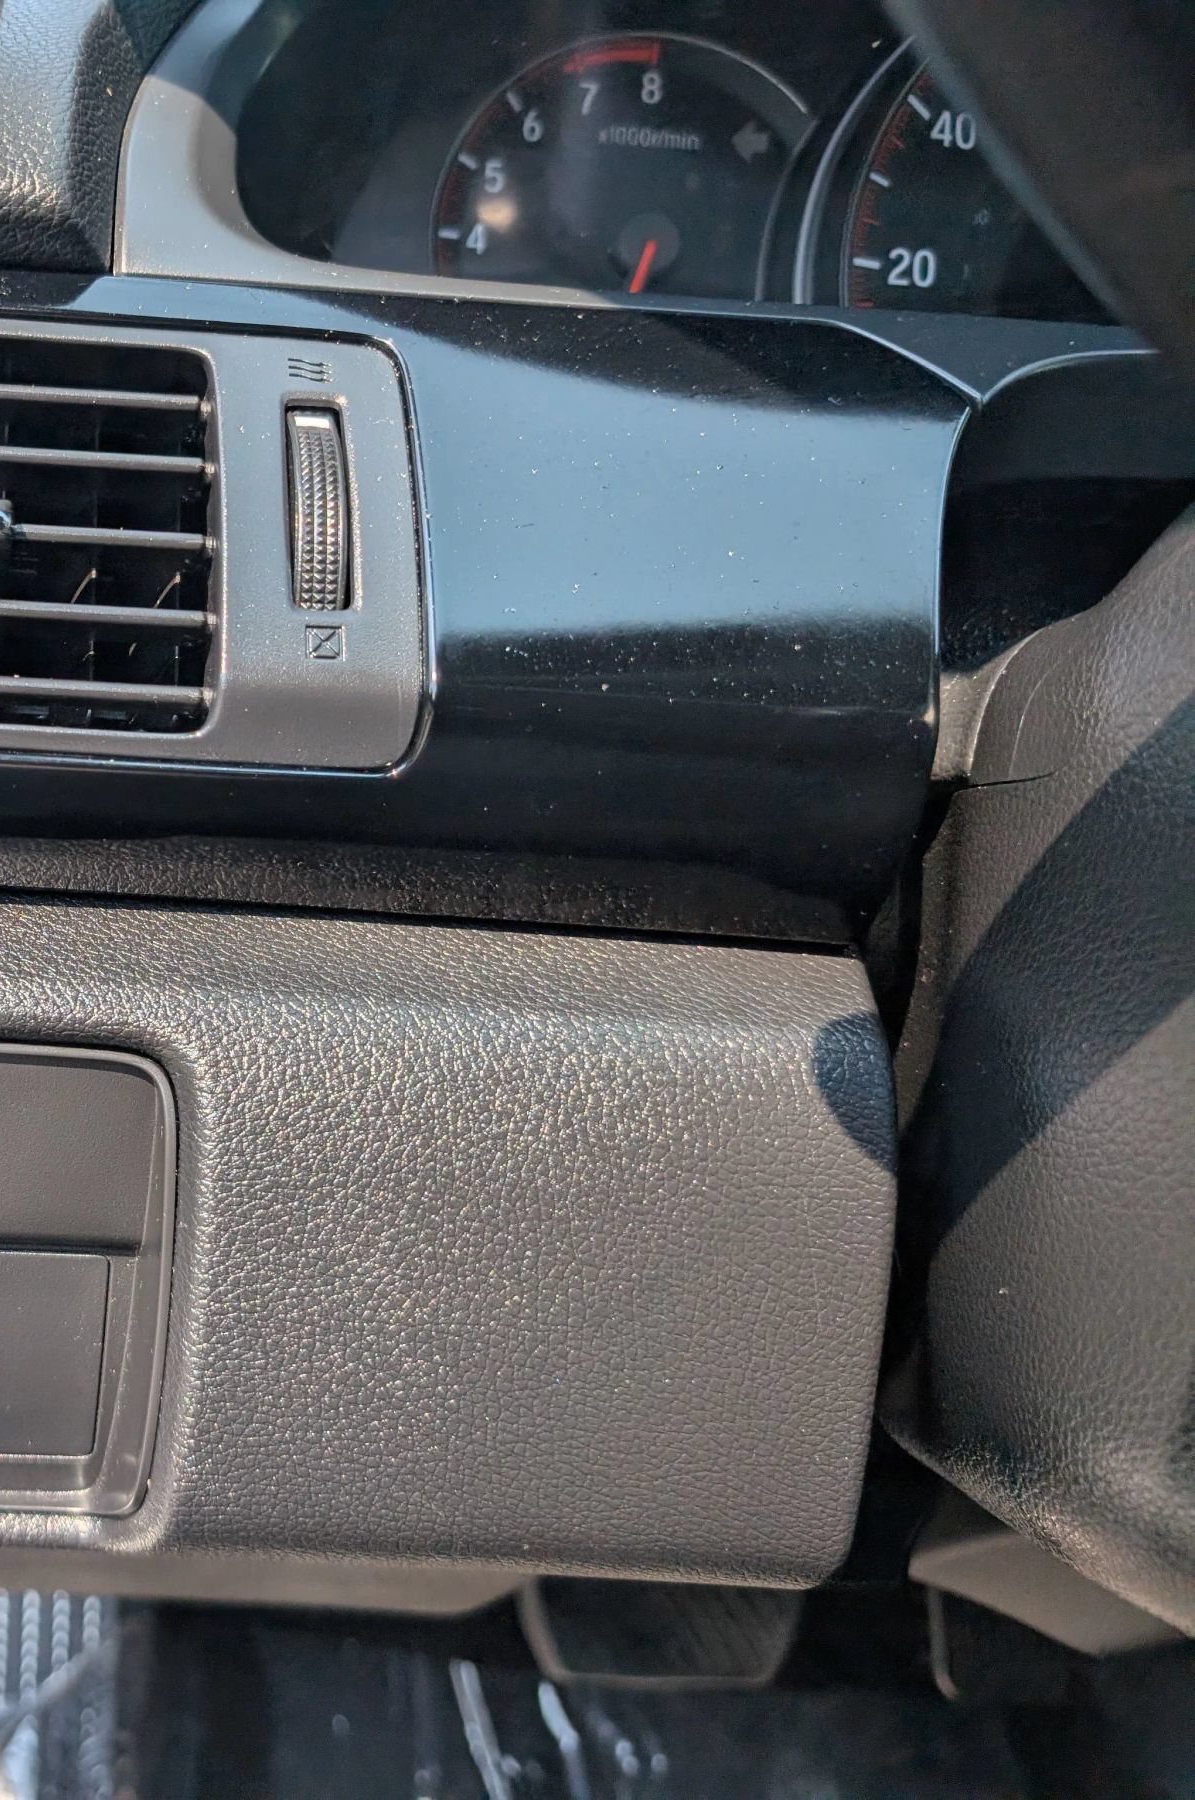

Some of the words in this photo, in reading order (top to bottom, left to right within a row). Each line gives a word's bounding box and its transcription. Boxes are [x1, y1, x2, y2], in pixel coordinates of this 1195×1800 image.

[579, 82, 598, 115] 7
[641, 71, 663, 104] 8
[522, 111, 543, 142] 6
[930, 110, 977, 150] 40
[483, 160, 504, 193] 5
[466, 223, 487, 255] 4
[887, 248, 935, 288] 20
